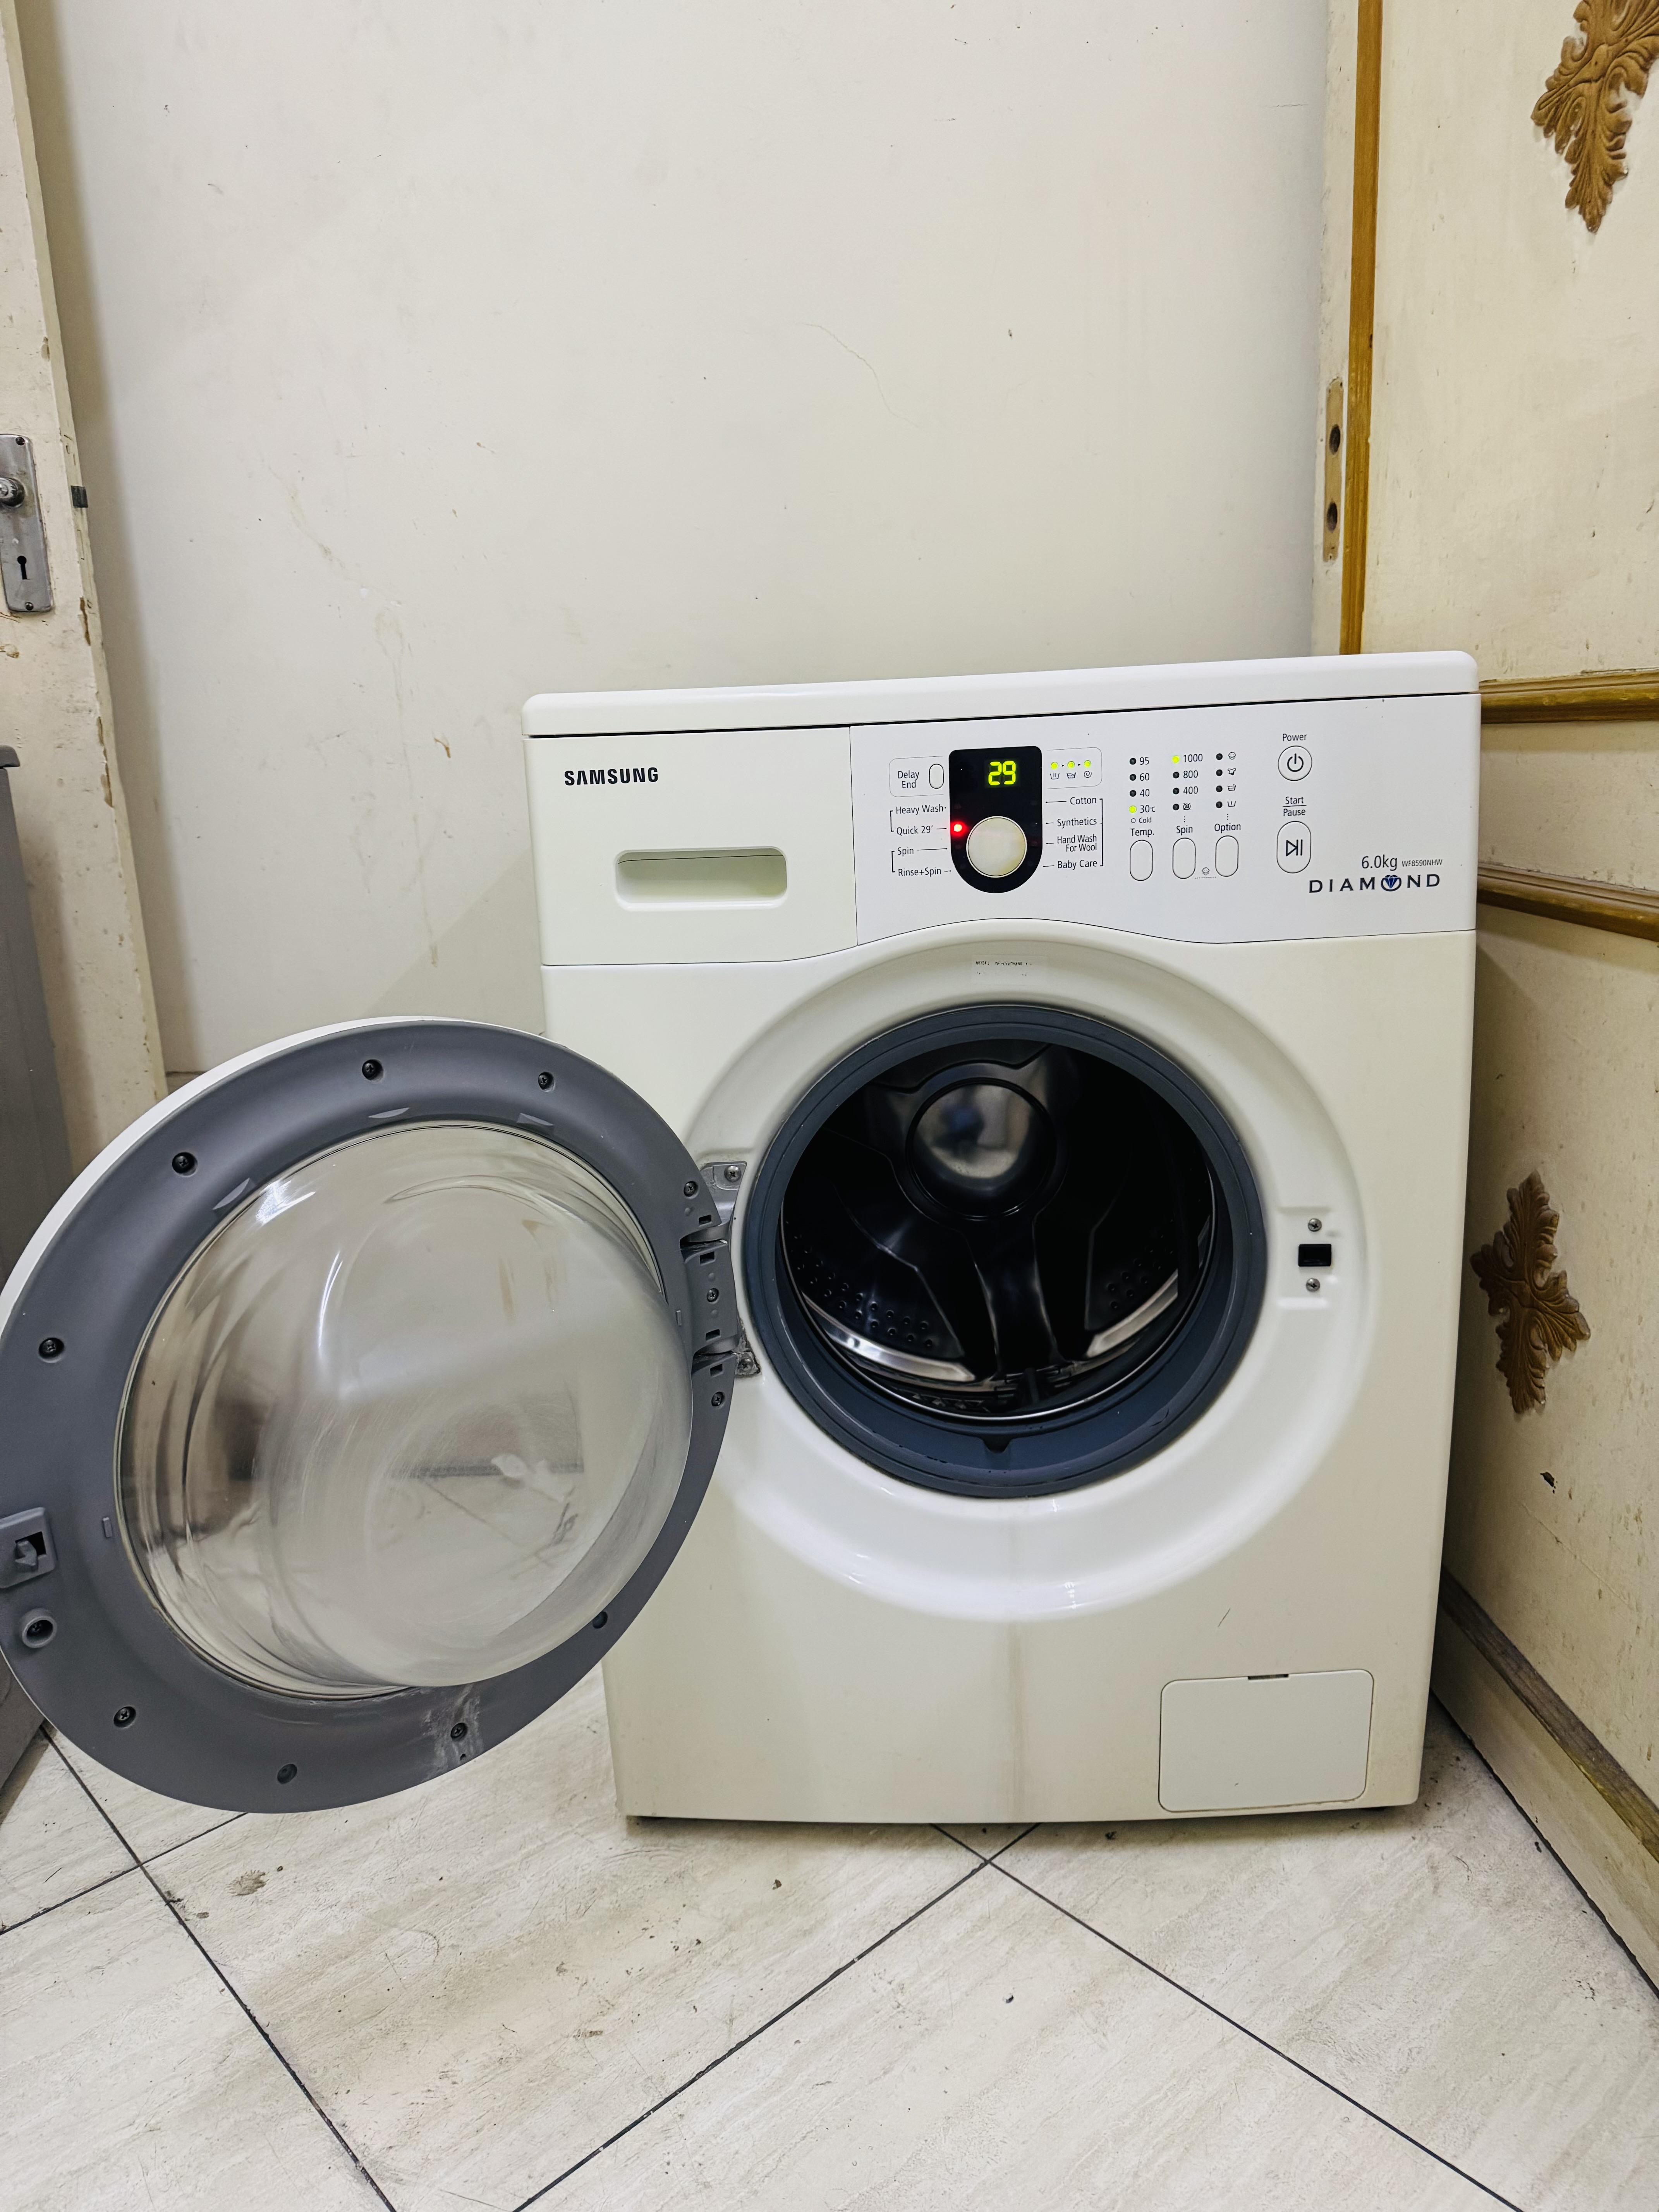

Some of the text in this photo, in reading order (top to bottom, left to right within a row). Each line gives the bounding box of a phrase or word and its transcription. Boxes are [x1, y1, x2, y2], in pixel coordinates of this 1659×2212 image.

[1283, 733, 1307, 742] Power
[1140, 756, 1149, 765] 95
[1183, 754, 1203, 763] 1000
[564, 767, 658, 786] SAMSUNG
[898, 770, 920, 781] Delay
[988, 761, 1016, 786] 29
[1140, 773, 1150, 781] 60
[1183, 770, 1198, 779] 800
[902, 780, 916, 788] End
[1140, 788, 1150, 797] 40
[1183, 786, 1198, 795] 400
[1070, 797, 1096, 805] Cotton
[1285, 796, 1304, 805] Start
[896, 804, 943, 816] Heavy Wash
[1283, 808, 1306, 817] Pause
[1057, 817, 1097, 829] Synthetics
[896, 826, 919, 836] Quick
[1130, 828, 1154, 838] Temp.
[1176, 825, 1193, 836] Spin
[1214, 823, 1241, 834] Option
[1057, 834, 1097, 844] Hand Wash
[897, 847, 914, 857] Spin
[1079, 842, 1097, 852] Wool
[1058, 859, 1097, 870] Baby Care
[1362, 854, 1397, 871] 6.0kg
[898, 867, 941, 877] Rinse+Spin
[1309, 874, 1440, 893] DIAMOND
